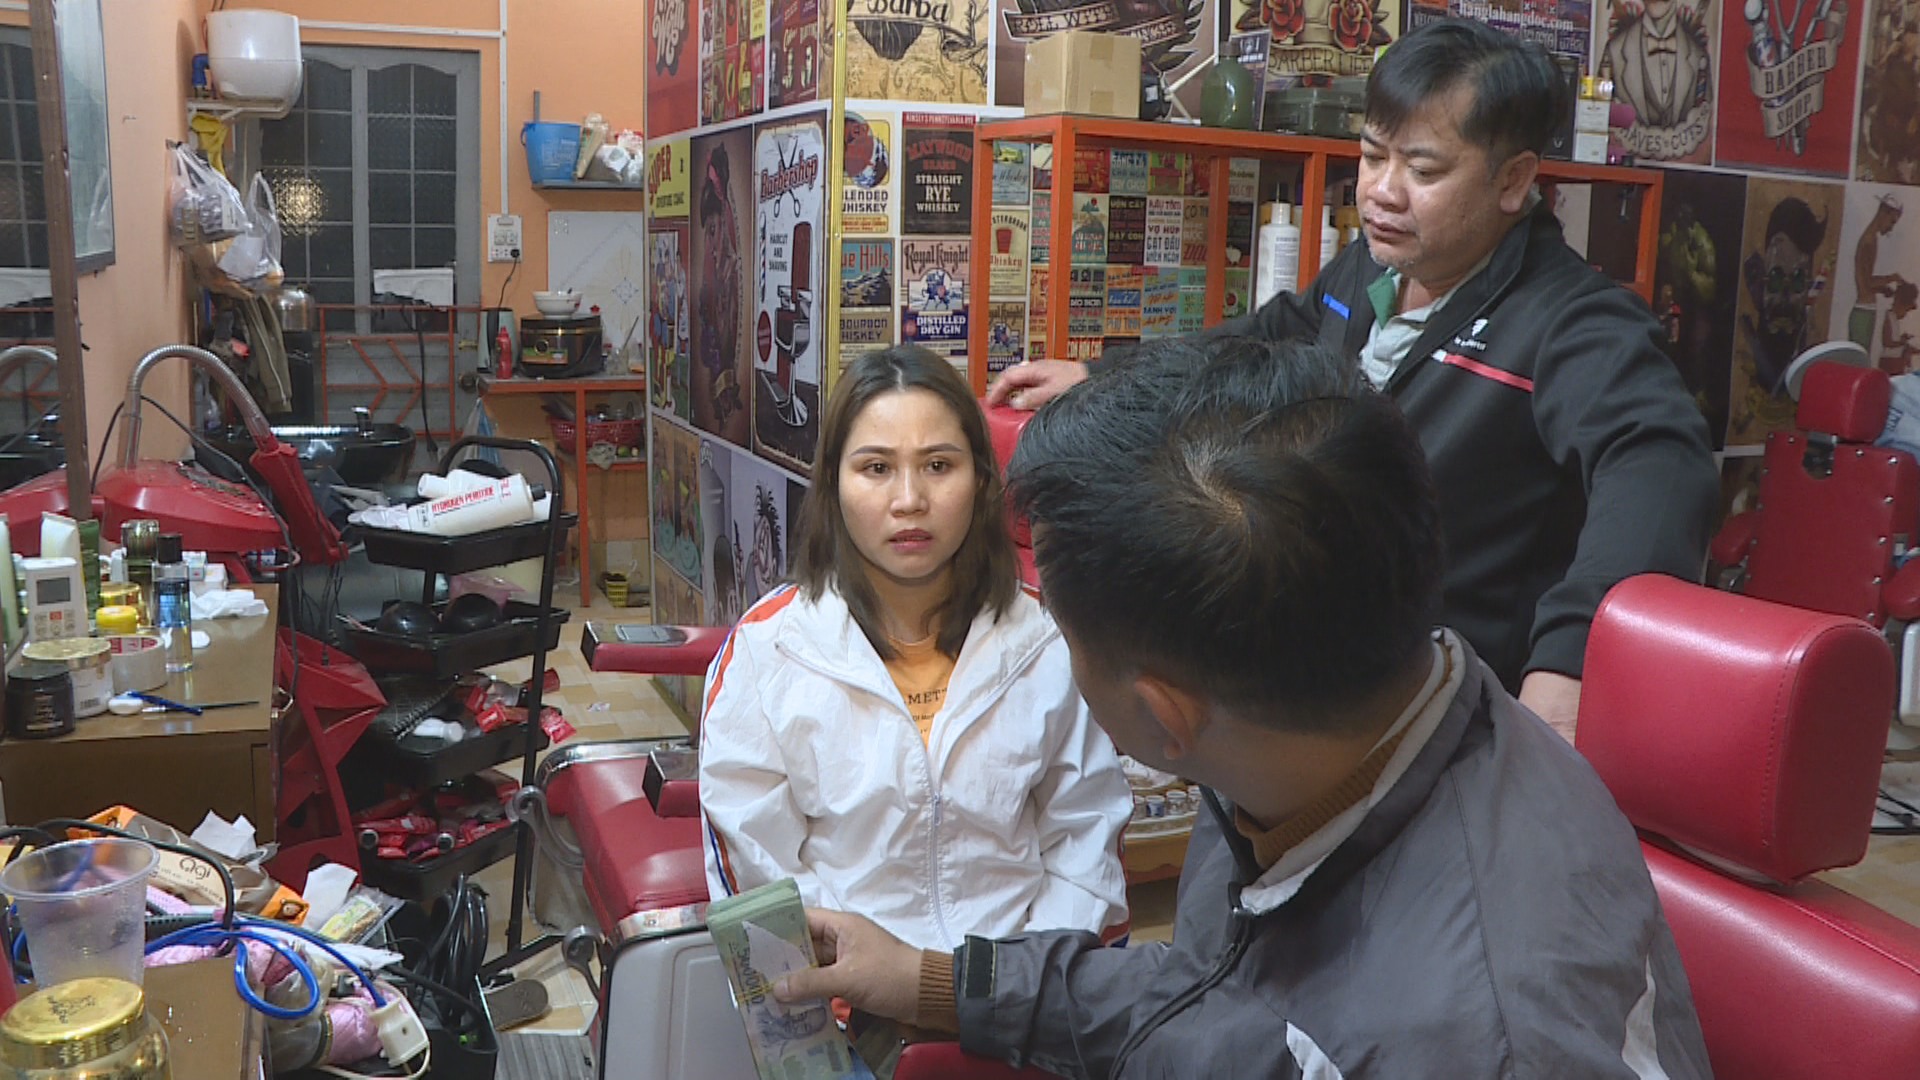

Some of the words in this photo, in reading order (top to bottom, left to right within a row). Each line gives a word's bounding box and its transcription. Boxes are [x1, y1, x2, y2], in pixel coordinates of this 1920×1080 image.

[1765, 47, 1826, 94] BARBER
[1777, 93, 1811, 130] SHOP
[760, 149, 818, 203] Barbershop
[915, 174, 963, 185] STRAIGHT
[844, 190, 889, 201] LENDED
[925, 185, 951, 202] RYE
[915, 202, 960, 212] WHISKEY
[992, 214, 1027, 231] STERBROOK
[773, 247, 783, 258] AND
[860, 245, 889, 272] Hills
[904, 242, 935, 275] Royal
[936, 240, 969, 274] Knight
[917, 314, 966, 326] DISTILLED
[841, 331, 882, 341] HISKEY
[921, 325, 942, 335] DRY
[943, 325, 961, 335] GIN
[432, 495, 464, 512] HYDROGEN
